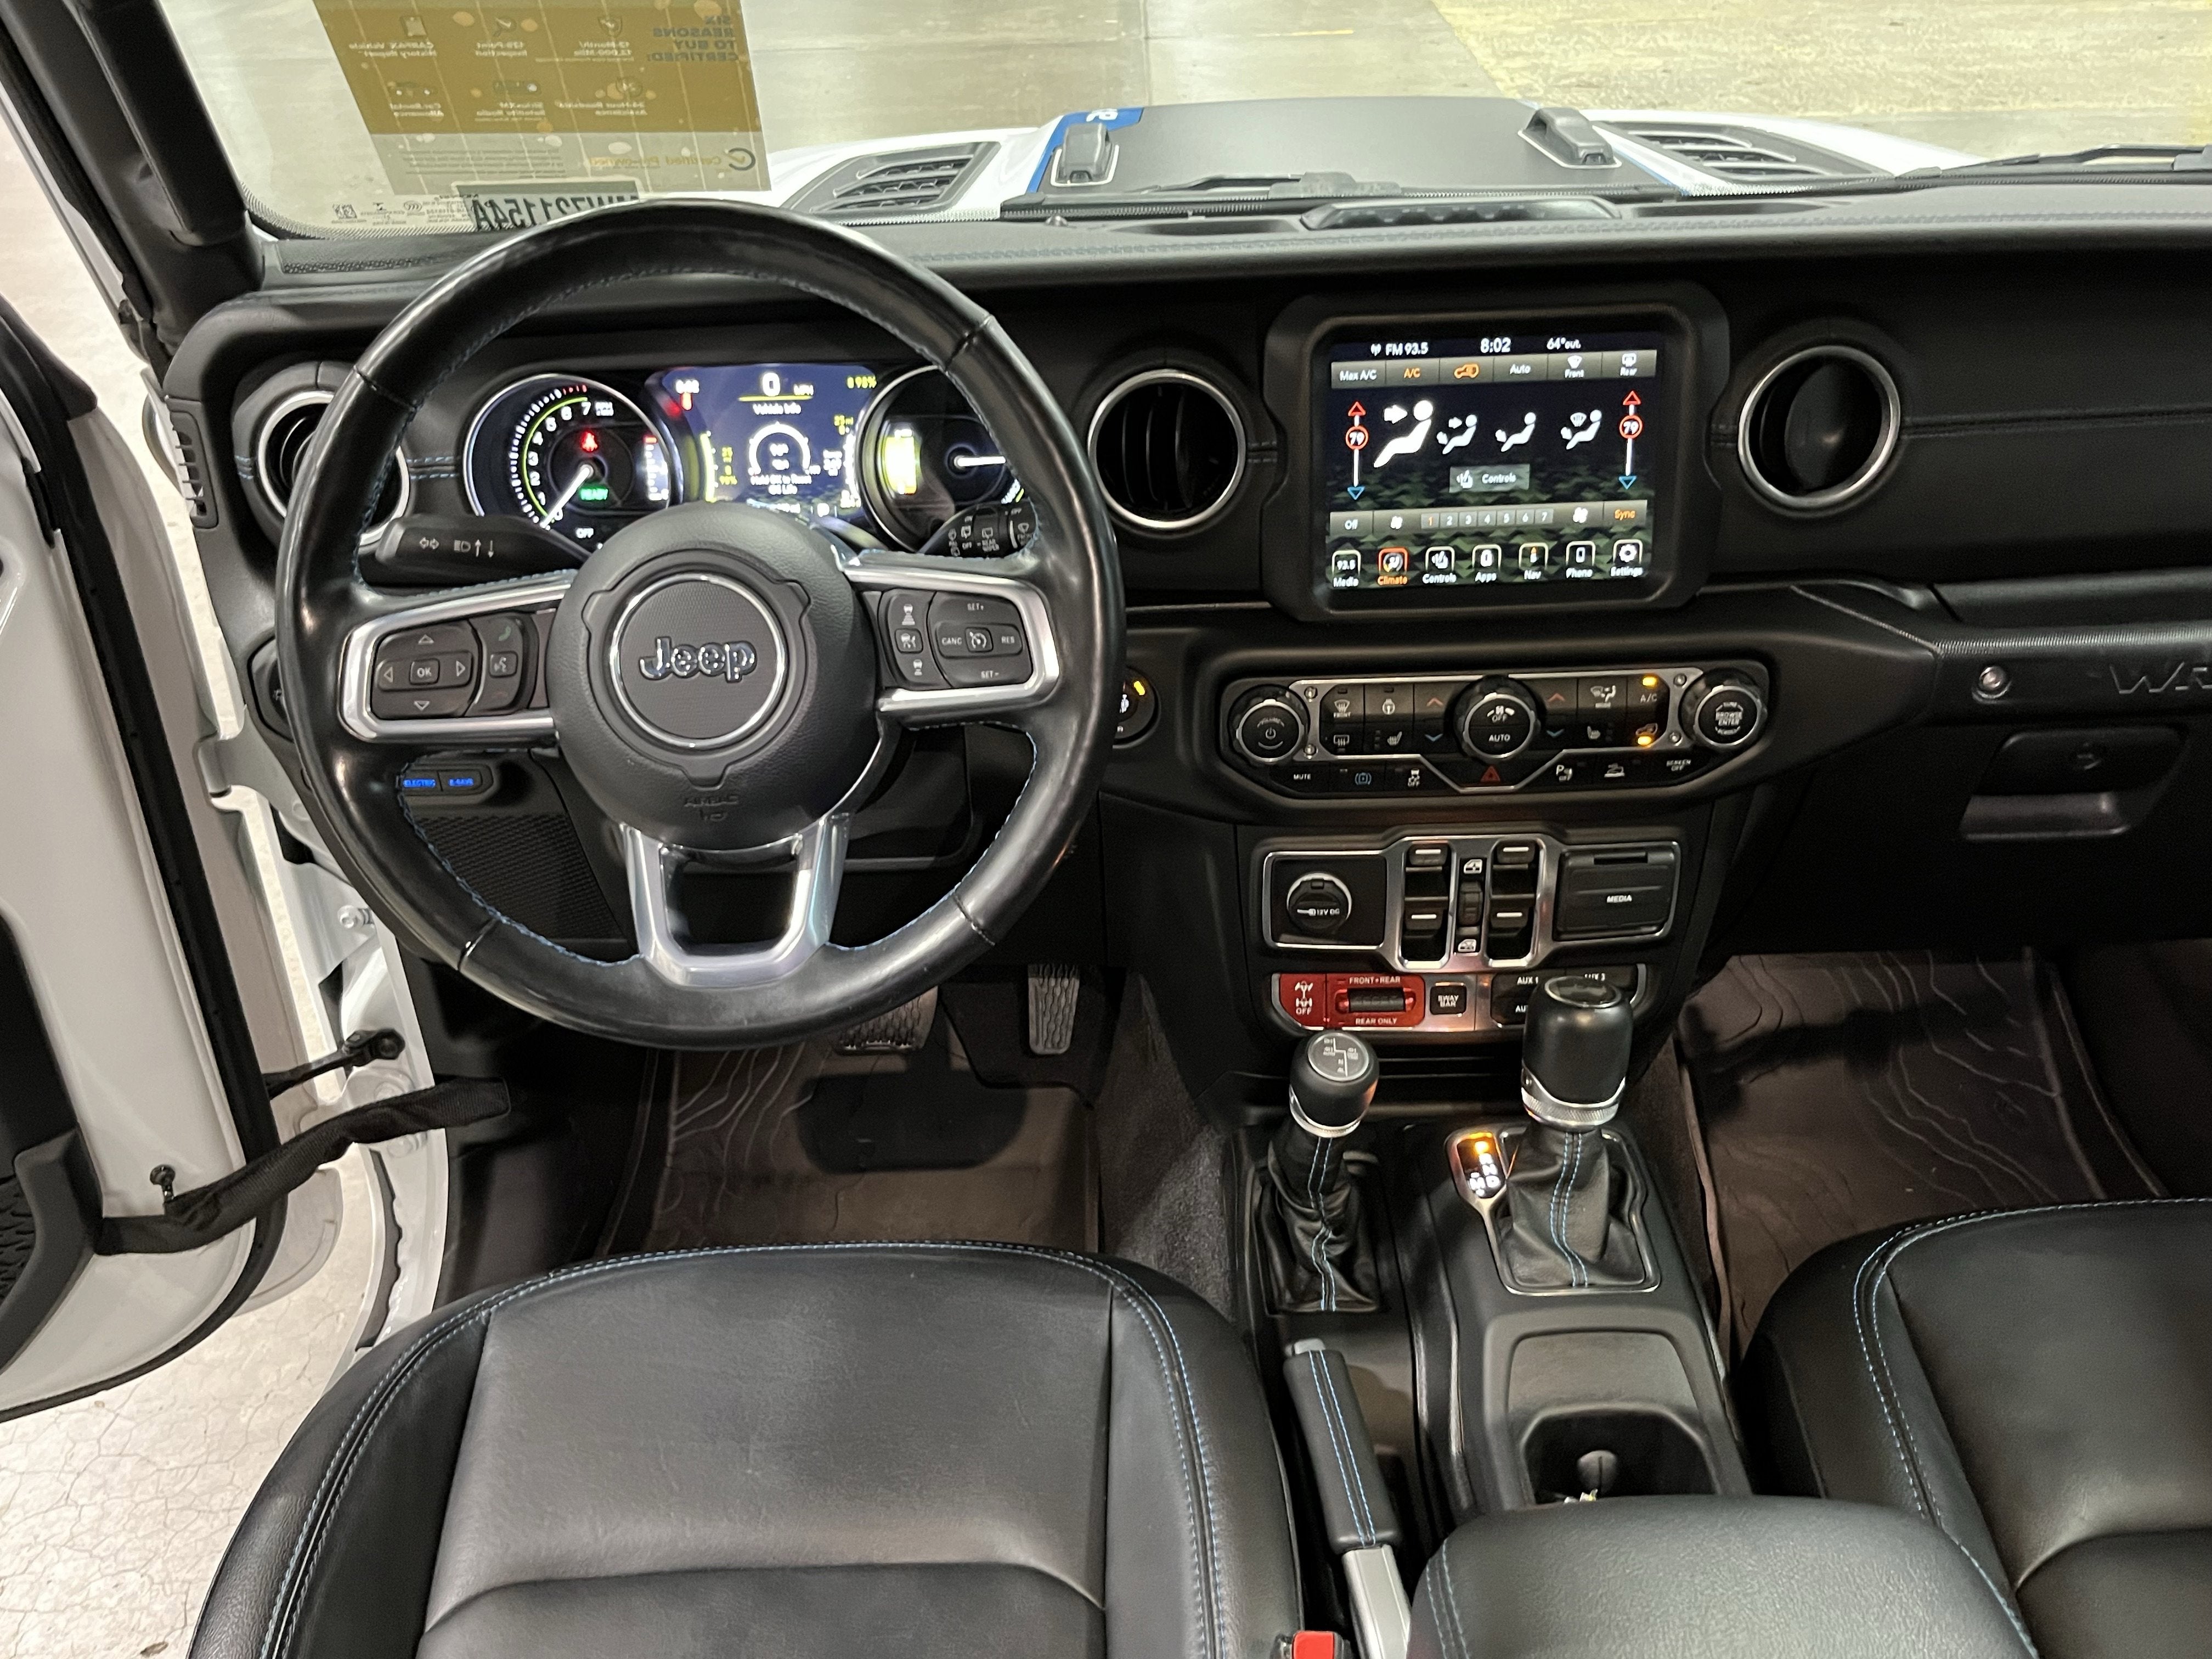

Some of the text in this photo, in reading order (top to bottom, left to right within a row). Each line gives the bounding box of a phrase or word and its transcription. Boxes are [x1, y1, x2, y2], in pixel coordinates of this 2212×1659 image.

[1385, 342, 1429, 356] FM 93.5
[1480, 337, 1511, 353] 8:02
[1339, 368, 1377, 381] Max A/C
[1403, 368, 1421, 379] A/C
[1510, 364, 1532, 374] Auto
[762, 373, 780, 397] 0
[581, 401, 591, 415] 7
[1623, 421, 1639, 435] 79
[532, 431, 544, 445] 4
[1349, 431, 1365, 445] 79
[530, 471, 541, 486] 2
[1482, 472, 1516, 484] Controls
[1428, 516, 1434, 526] 1
[1447, 515, 1453, 526] 2
[1465, 515, 1472, 525] 3
[1484, 514, 1491, 524] 4
[1503, 513, 1510, 523] 5
[1522, 512, 1529, 522] 6
[1541, 511, 1548, 522] 7
[1475, 572, 1497, 583] Apps
[1523, 570, 1542, 579] Nav
[1566, 568, 1593, 579] Phone
[1610, 566, 1644, 578] Settings
[1333, 577, 1359, 588] Media
[1377, 575, 1408, 585] Climate
[1422, 573, 1457, 584] Controls
[639, 636, 757, 683] Jeep
[416, 667, 432, 678] OK
[1640, 693, 1658, 703] A/C
[1491, 714, 1507, 723] OFF
[1488, 733, 1510, 742] AUTO
[1606, 894, 1632, 903] MEDIA
[1517, 976, 1533, 985] AUX
[1515, 1005, 1528, 1013] AU
[1482, 1164, 1499, 1176] N
